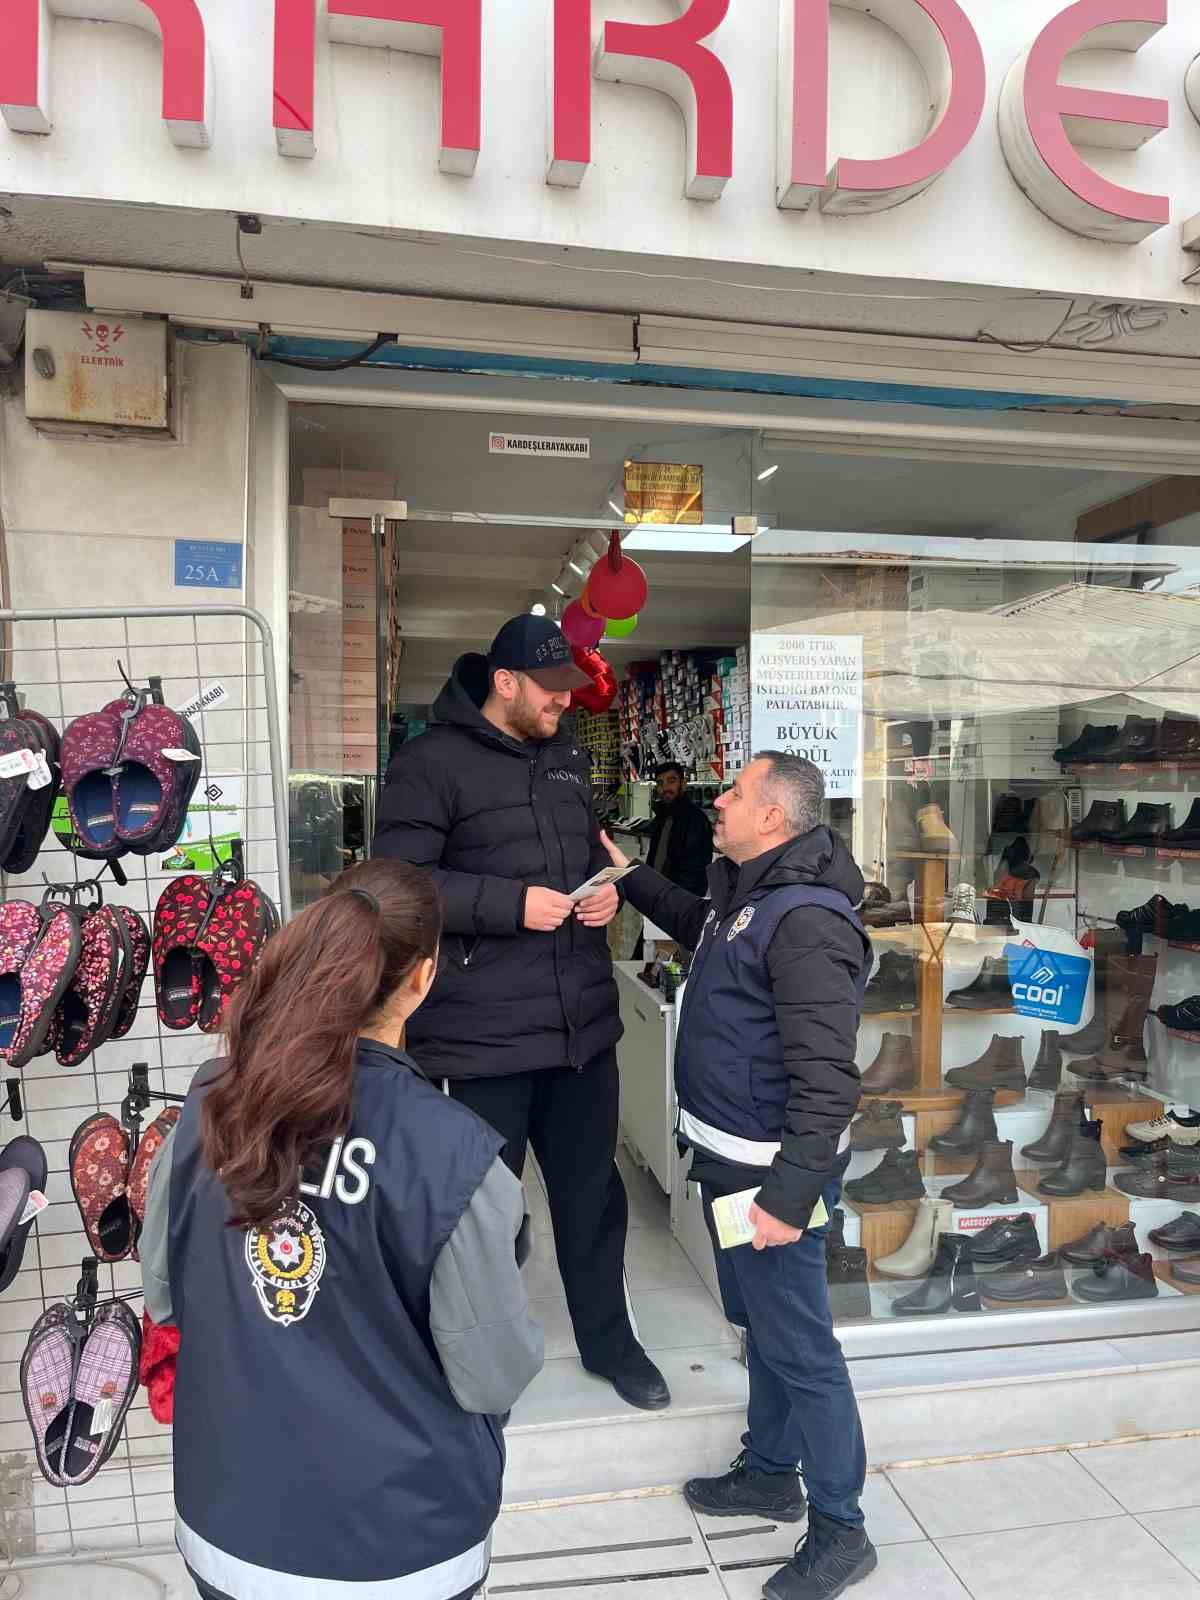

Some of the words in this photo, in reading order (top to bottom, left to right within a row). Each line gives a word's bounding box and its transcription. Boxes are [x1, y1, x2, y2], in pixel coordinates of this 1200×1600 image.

[507, 439, 588, 453] KARDEŞLERAYAKKABI
[184, 564, 219, 581] 25A
[818, 655, 856, 666] YAPAN
[810, 684, 857, 696] BALONU
[776, 722, 839, 740] BÜYÜK
[1011, 982, 1064, 1006] cool
